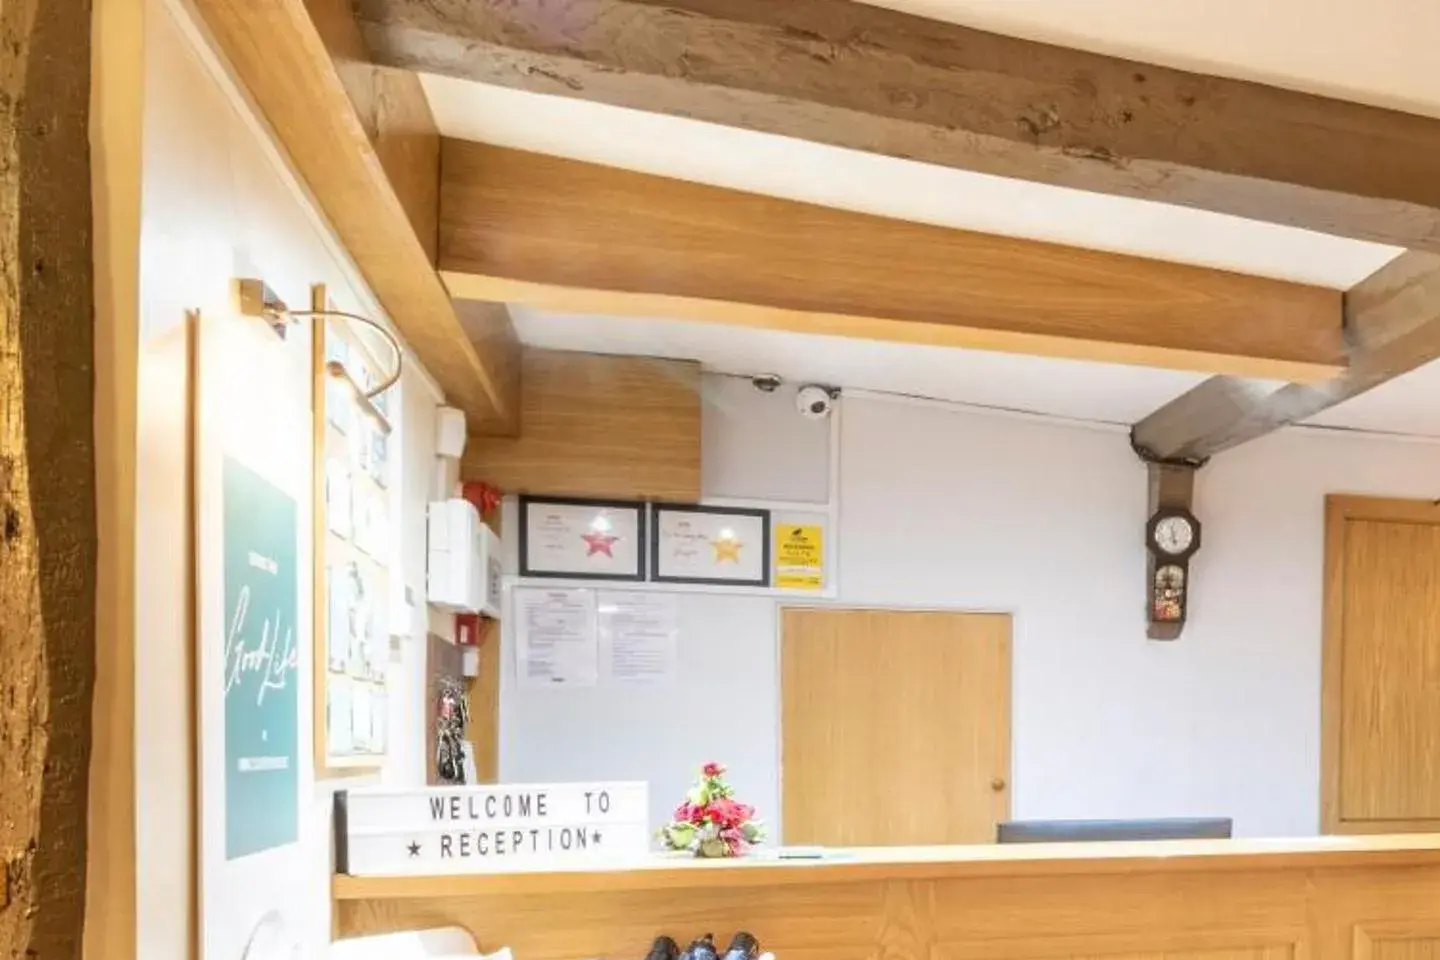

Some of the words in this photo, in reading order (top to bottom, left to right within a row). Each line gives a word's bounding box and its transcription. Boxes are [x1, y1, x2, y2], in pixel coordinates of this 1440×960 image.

[429, 793, 548, 820] WELCOME
[584, 791, 610, 813] TO
[440, 828, 587, 858] RECEPTION
